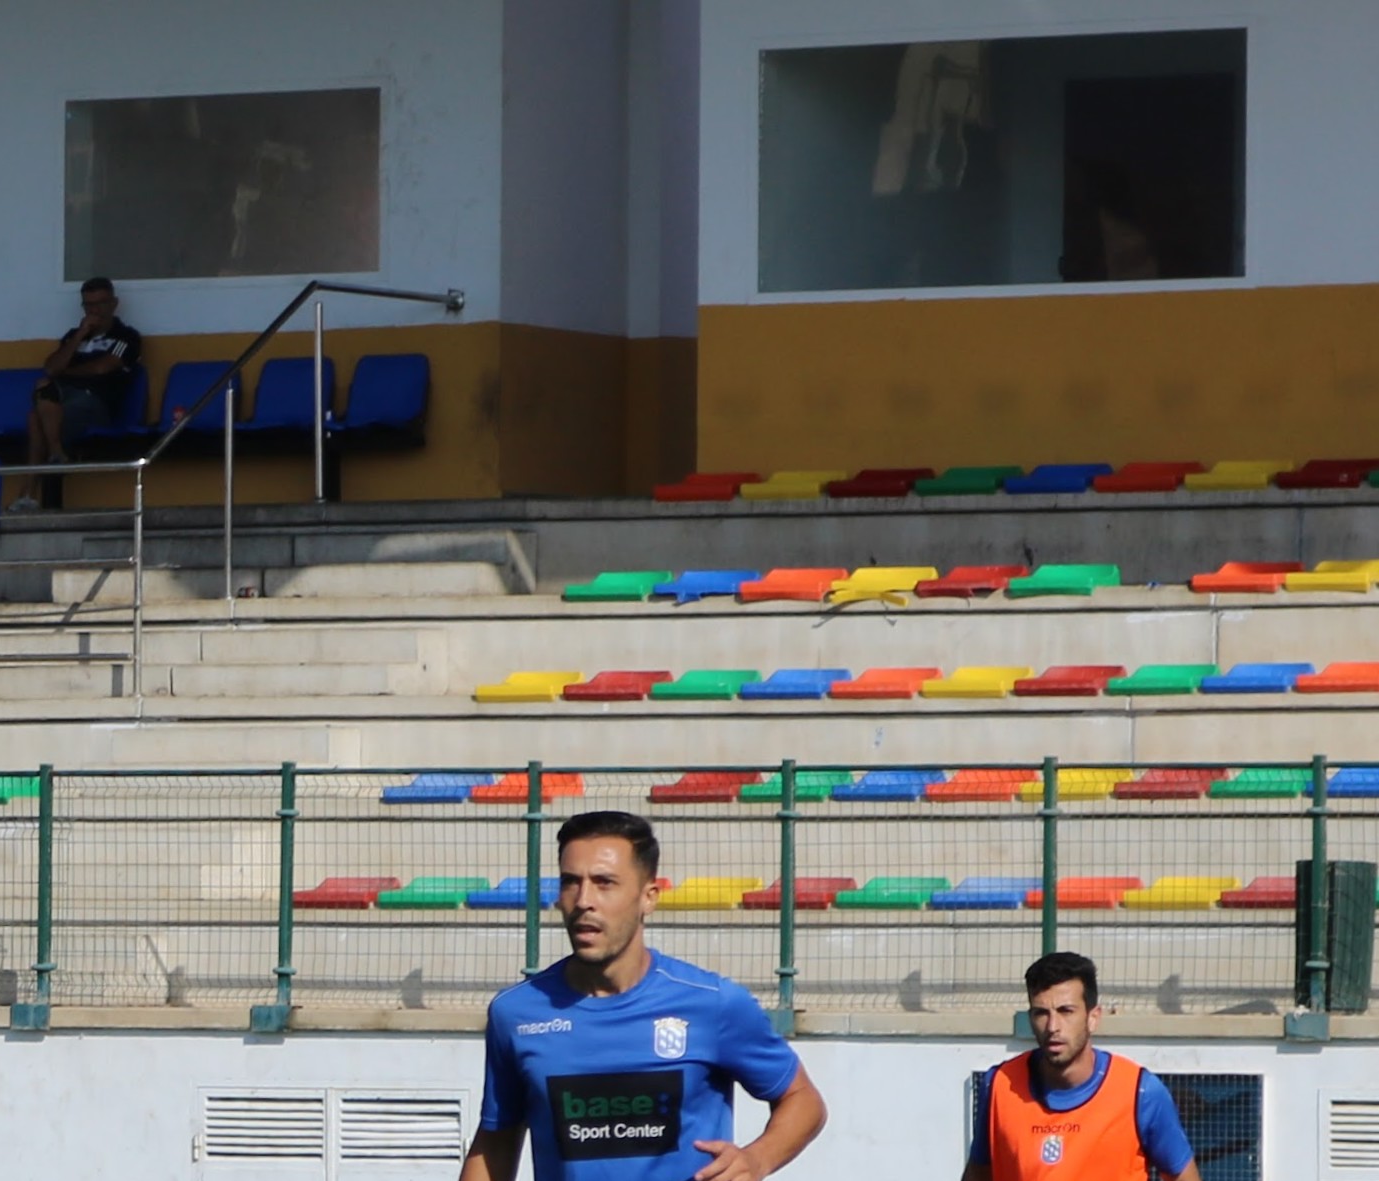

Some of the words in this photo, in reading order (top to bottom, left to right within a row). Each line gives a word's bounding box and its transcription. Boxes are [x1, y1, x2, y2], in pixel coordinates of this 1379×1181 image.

[517, 1018, 572, 1036] macron
[569, 1124, 610, 1142] Sport
[614, 1123, 666, 1139] Center
[1031, 1123, 1080, 1134] macron
